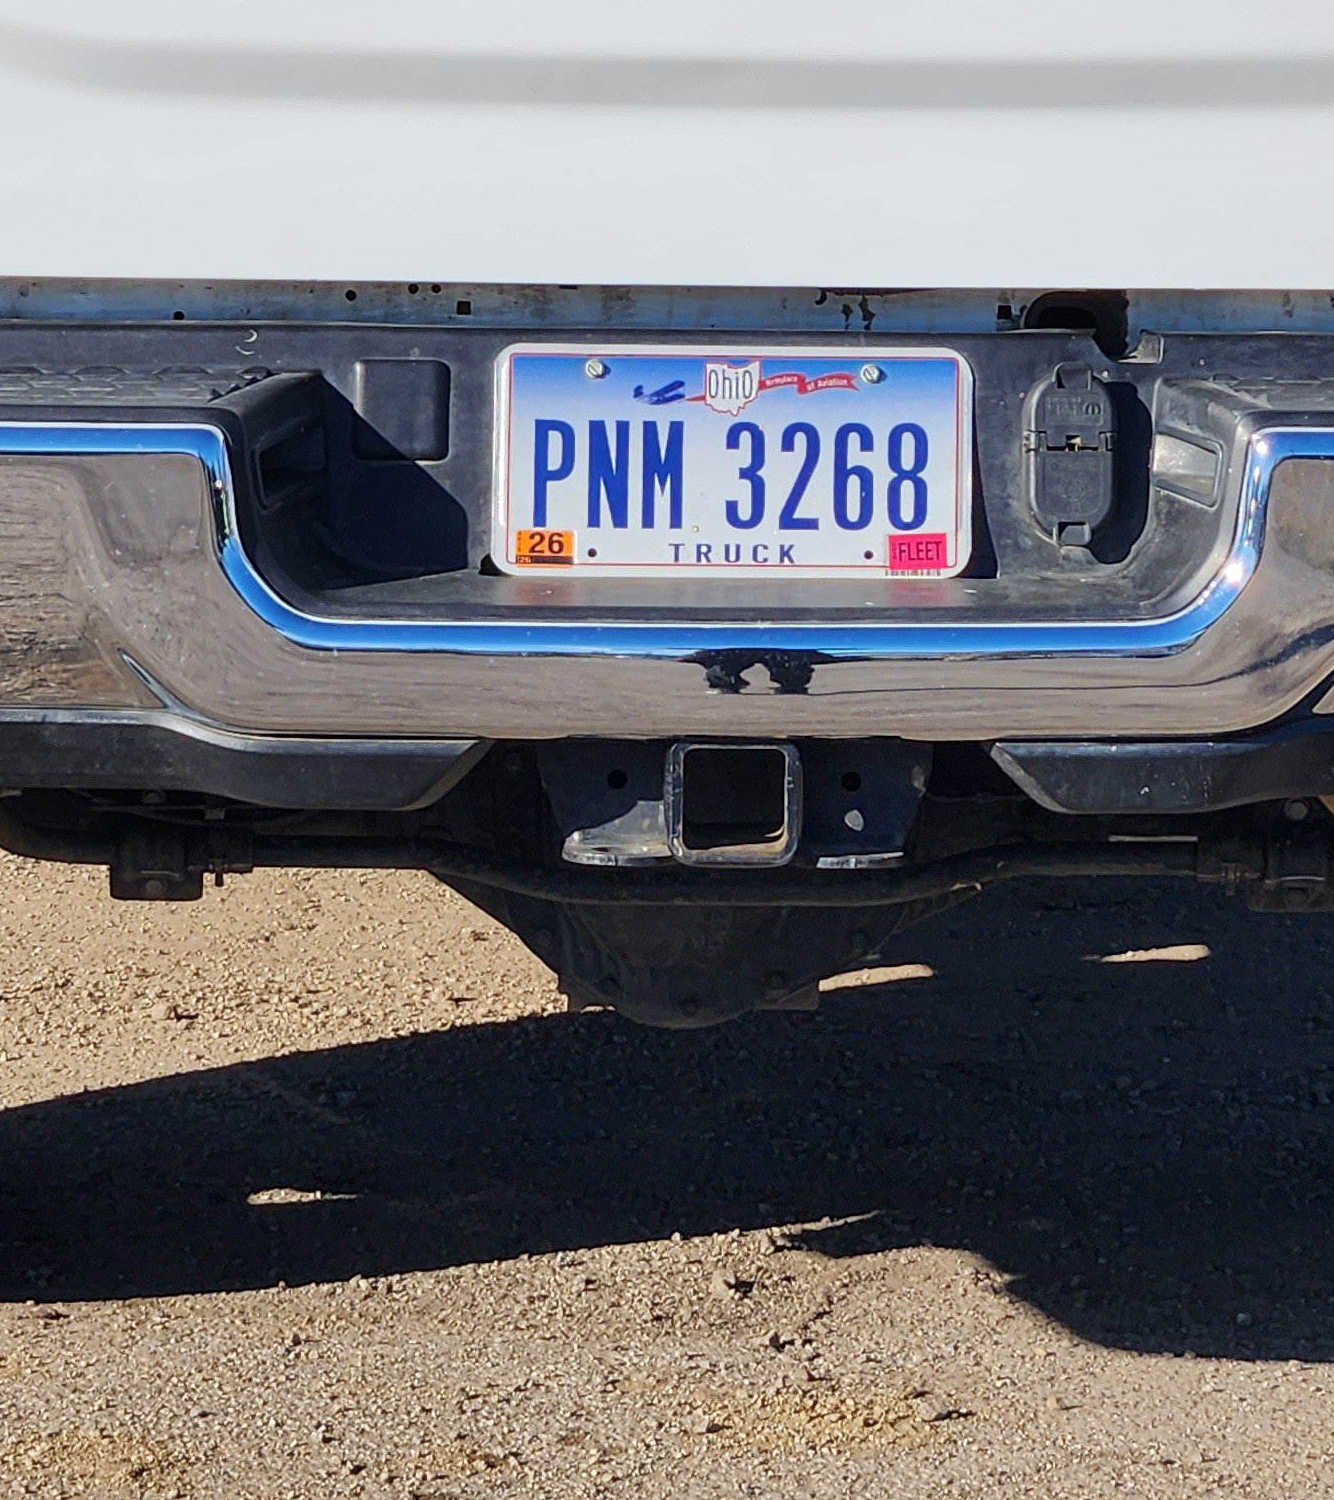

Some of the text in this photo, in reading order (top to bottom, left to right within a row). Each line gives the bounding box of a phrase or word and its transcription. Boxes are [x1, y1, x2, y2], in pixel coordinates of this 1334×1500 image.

[818, 378, 848, 389] Aviation
[533, 419, 929, 531] PNM 3268
[529, 532, 564, 554] 26
[668, 543, 795, 564] TRUCK
[898, 541, 942, 562] FLEET
